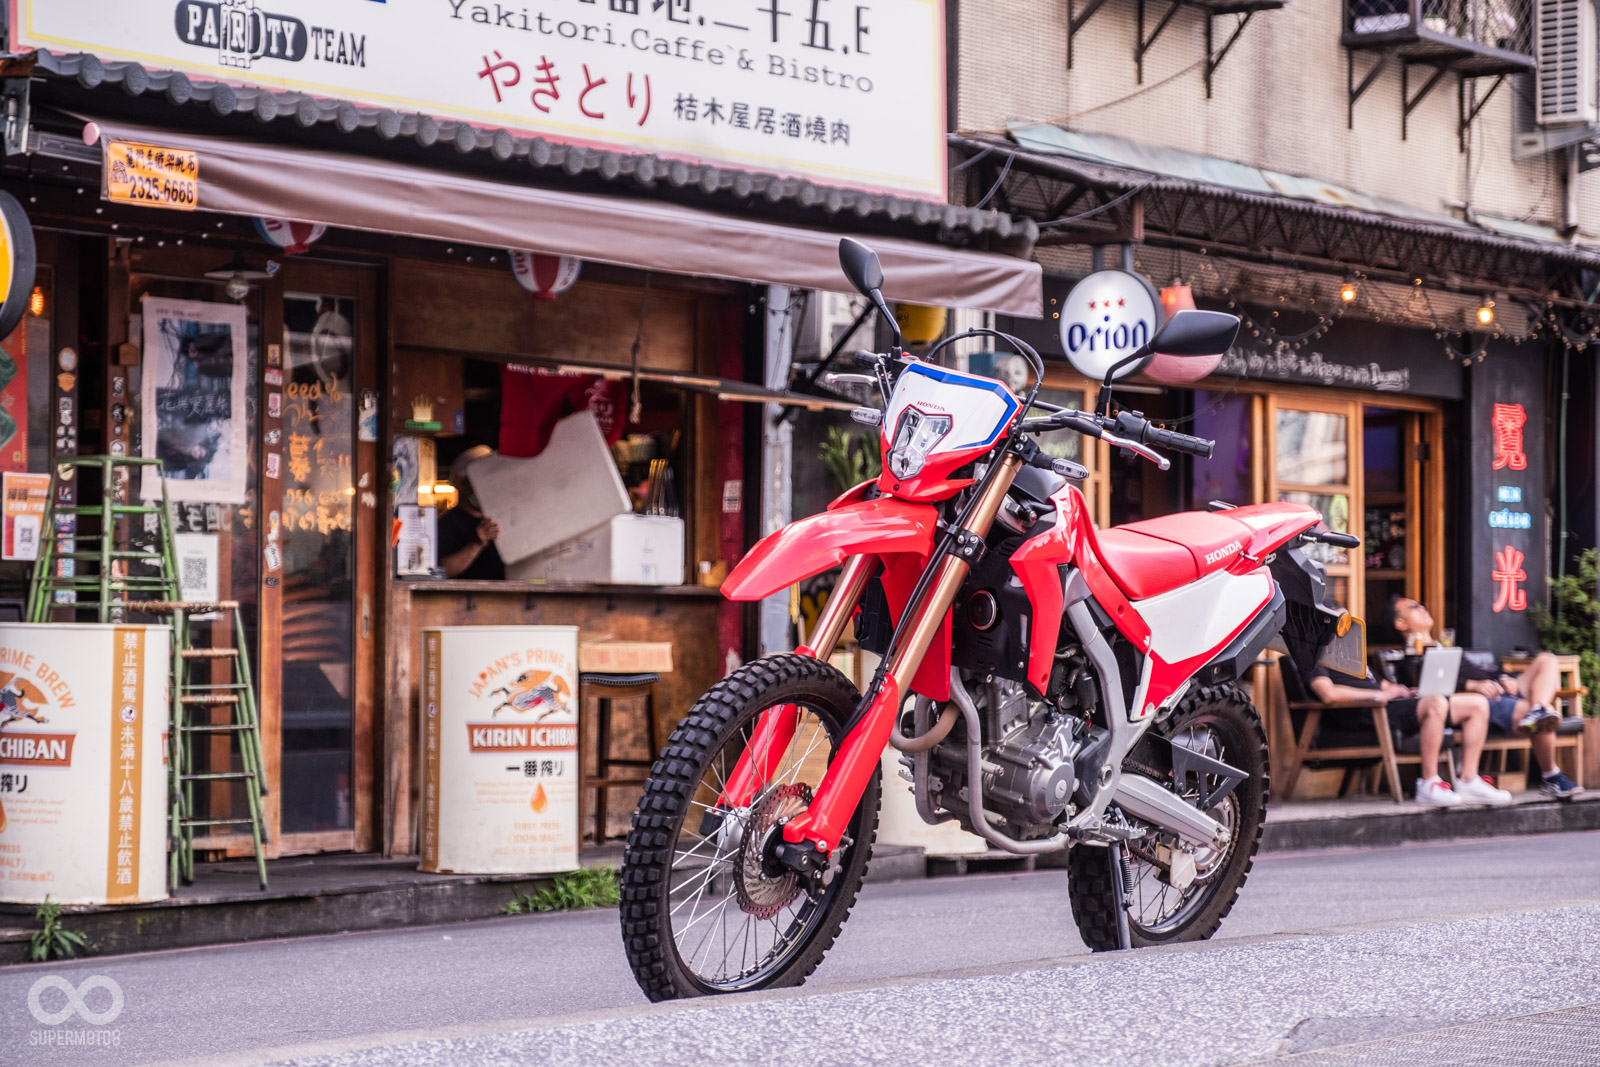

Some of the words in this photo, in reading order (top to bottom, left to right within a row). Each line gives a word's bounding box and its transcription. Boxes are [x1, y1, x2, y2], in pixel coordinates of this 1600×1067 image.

[311, 26, 366, 68] TEAM
[738, 48, 754, 71] &
[768, 54, 874, 93] Bistro
[477, 50, 652, 126] やきとり
[129, 176, 194, 203] 2325-6666
[916, 401, 946, 412] HONDA
[1204, 540, 1243, 565] HONDA
[526, 648, 564, 668] PRIME
[35, 662, 76, 708] BREW
[473, 728, 528, 748] KIRIN
